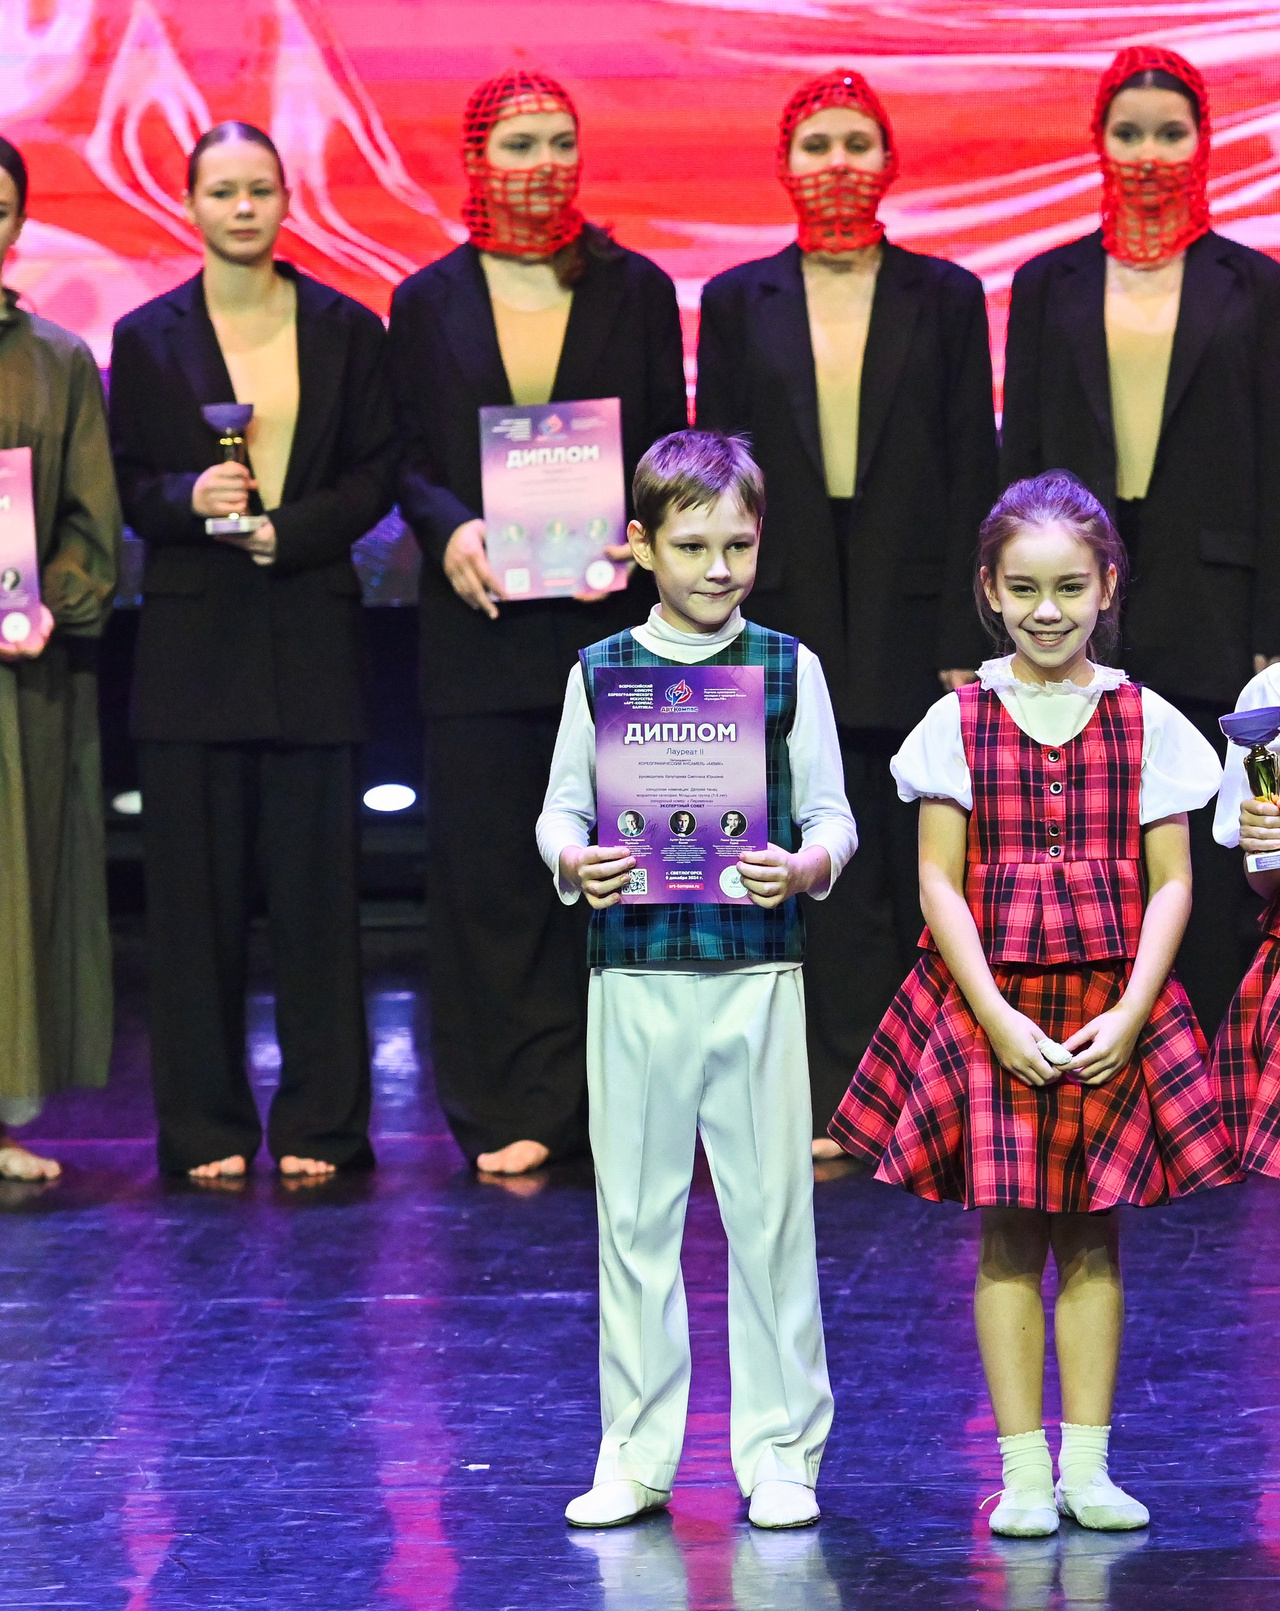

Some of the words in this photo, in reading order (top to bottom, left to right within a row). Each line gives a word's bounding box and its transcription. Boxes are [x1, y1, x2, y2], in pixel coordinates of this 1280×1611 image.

[507, 445, 599, 469] ДИПЛОМ
[624, 723, 737, 745] ДИПЛОМ
[666, 748, 697, 757] Лауреат
